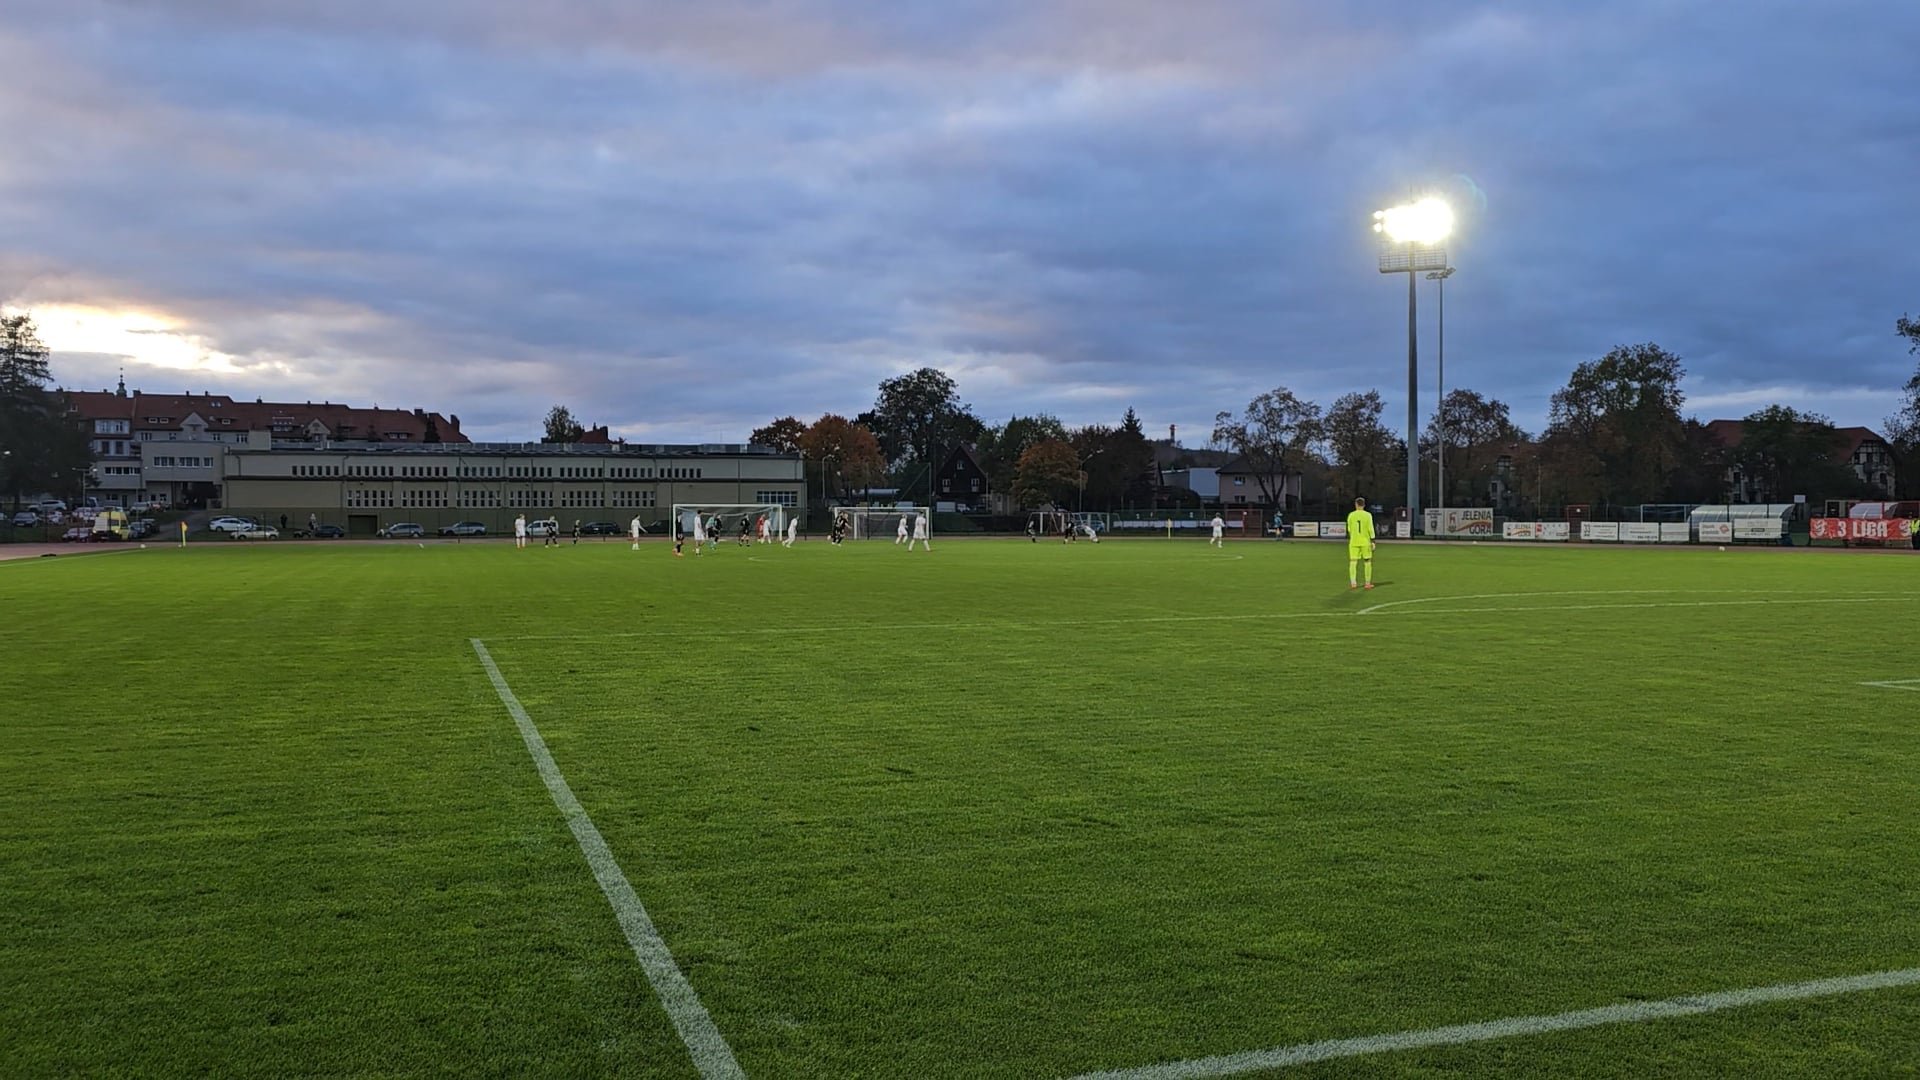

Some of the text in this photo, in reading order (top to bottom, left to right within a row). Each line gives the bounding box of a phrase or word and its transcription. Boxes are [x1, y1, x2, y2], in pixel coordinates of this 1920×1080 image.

[1461, 510, 1492, 521] JELENIA
[1356, 519, 1362, 534] 1
[1837, 521, 1888, 538] 3 LIGA
